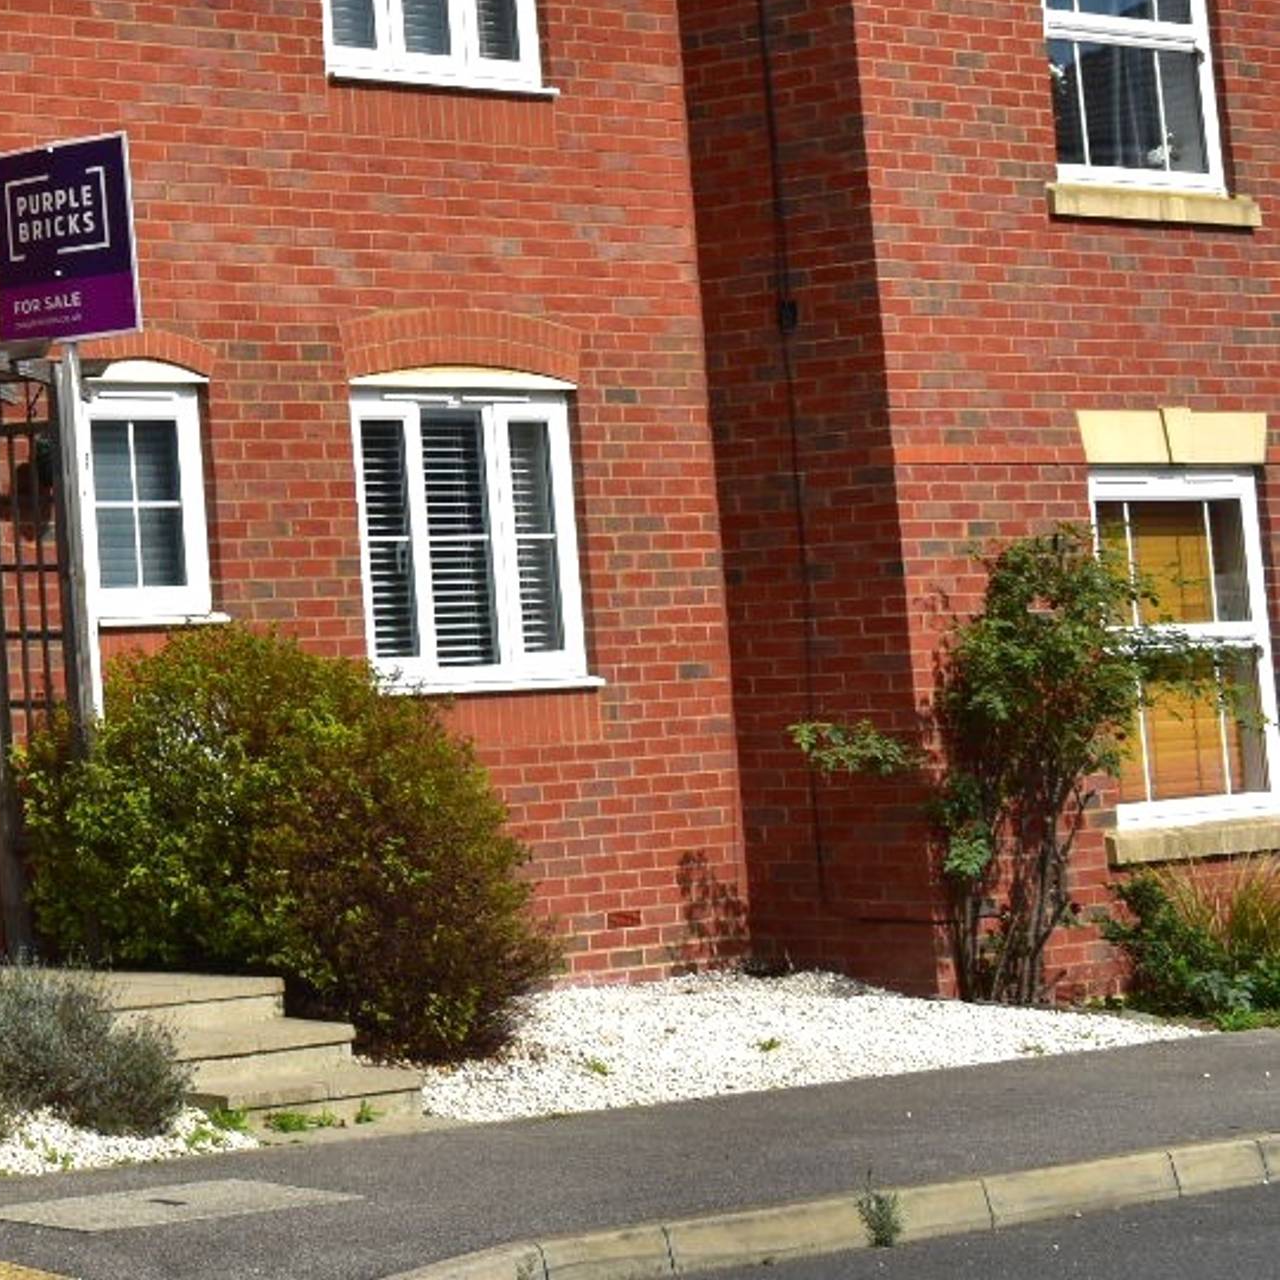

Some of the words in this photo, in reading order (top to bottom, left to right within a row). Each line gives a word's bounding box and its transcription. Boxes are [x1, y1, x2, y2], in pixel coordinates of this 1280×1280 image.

[15, 184, 94, 217] PURPLE
[18, 211, 96, 243] BRICKS
[13, 298, 41, 315] FOR
[44, 291, 82, 310] SALE
